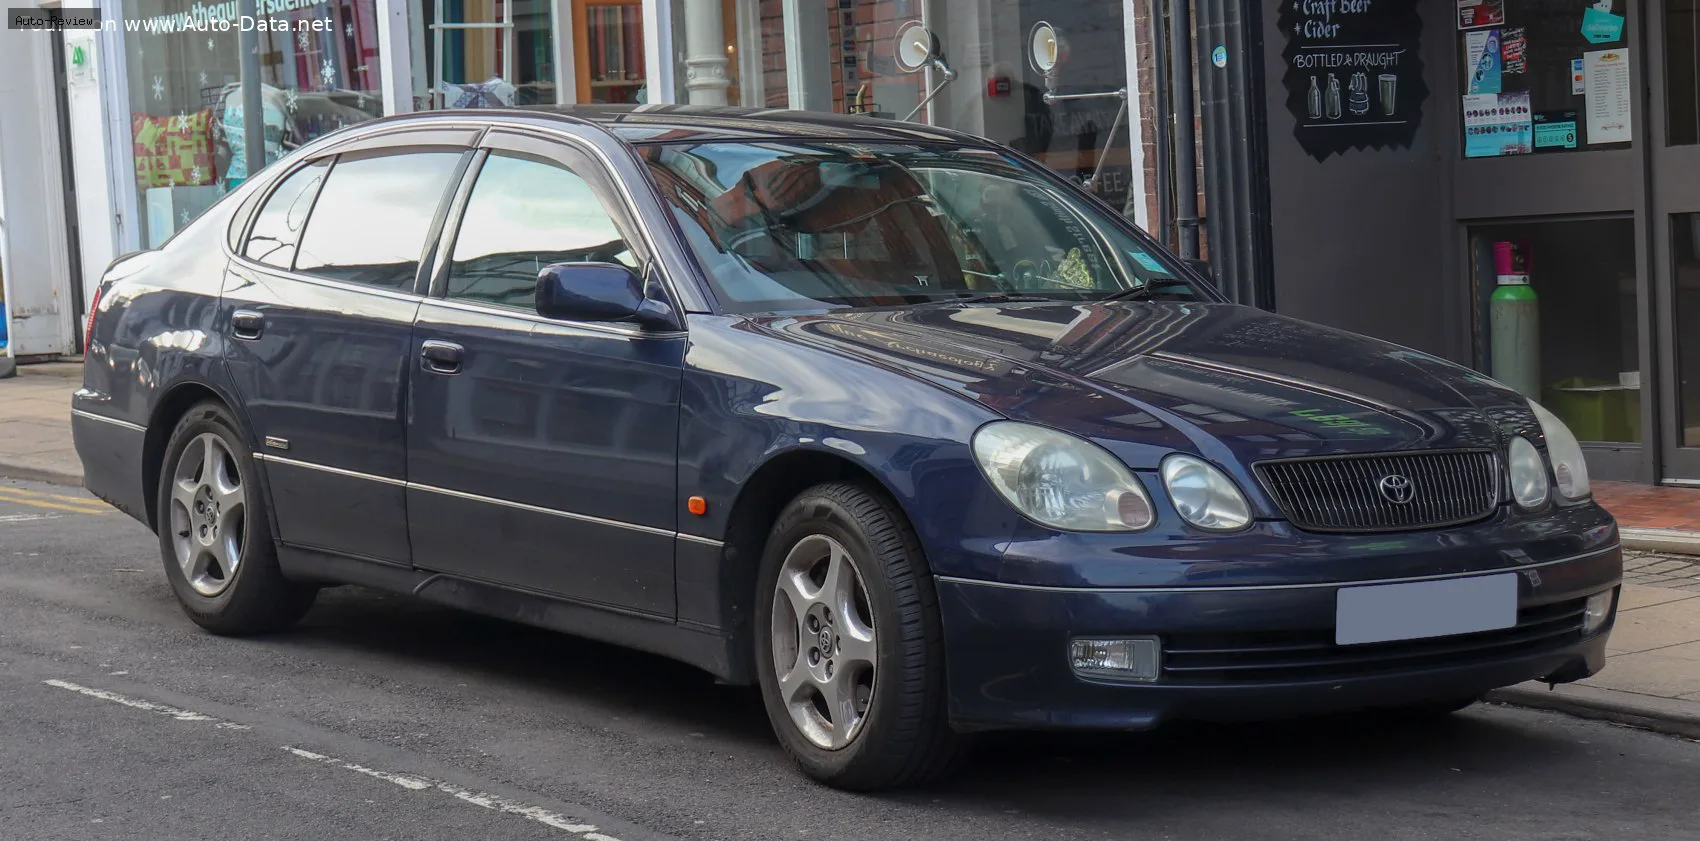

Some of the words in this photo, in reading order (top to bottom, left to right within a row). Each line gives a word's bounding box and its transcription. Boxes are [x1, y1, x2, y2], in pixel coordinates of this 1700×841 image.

[1302, 0, 1336, 22] Craft
[1304, 20, 1340, 38] Cider
[1293, 53, 1343, 68] BOTTLED
[1354, 49, 1407, 71] DRAUGHT
